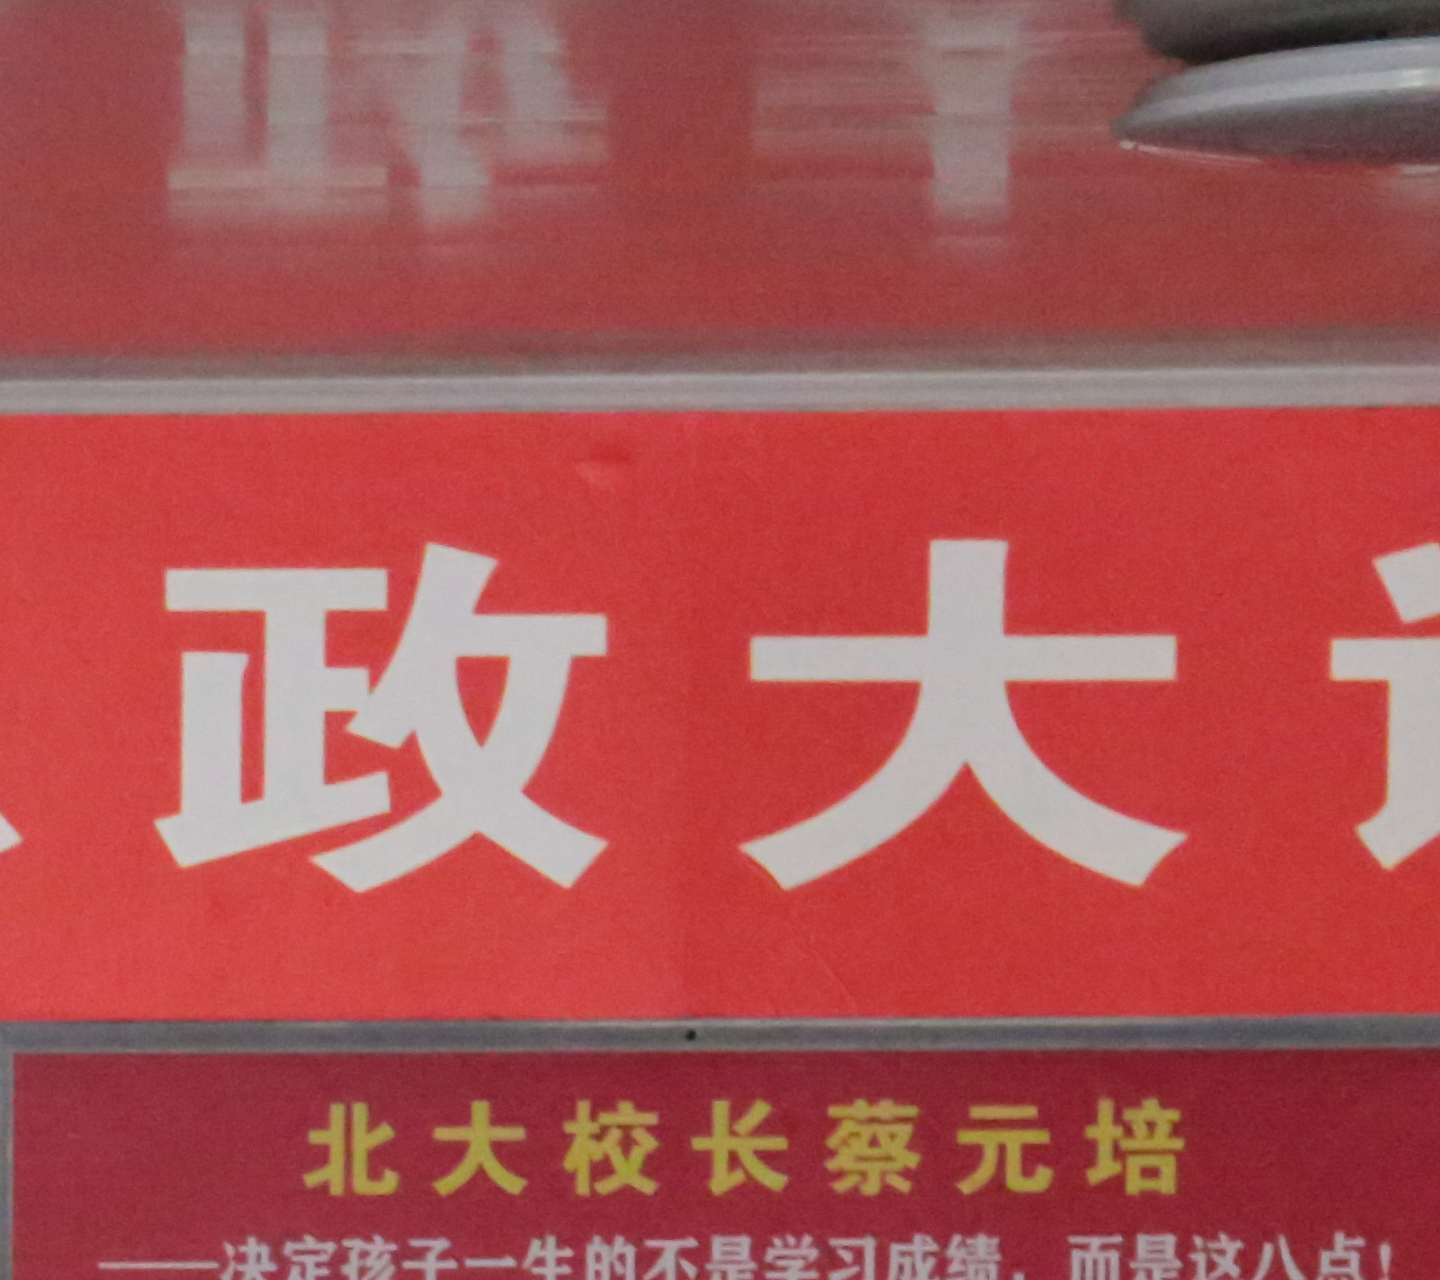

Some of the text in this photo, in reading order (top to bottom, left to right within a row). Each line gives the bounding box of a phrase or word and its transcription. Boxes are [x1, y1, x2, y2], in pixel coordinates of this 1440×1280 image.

[301, 1098, 1187, 1198] 北大校长蔡元培
